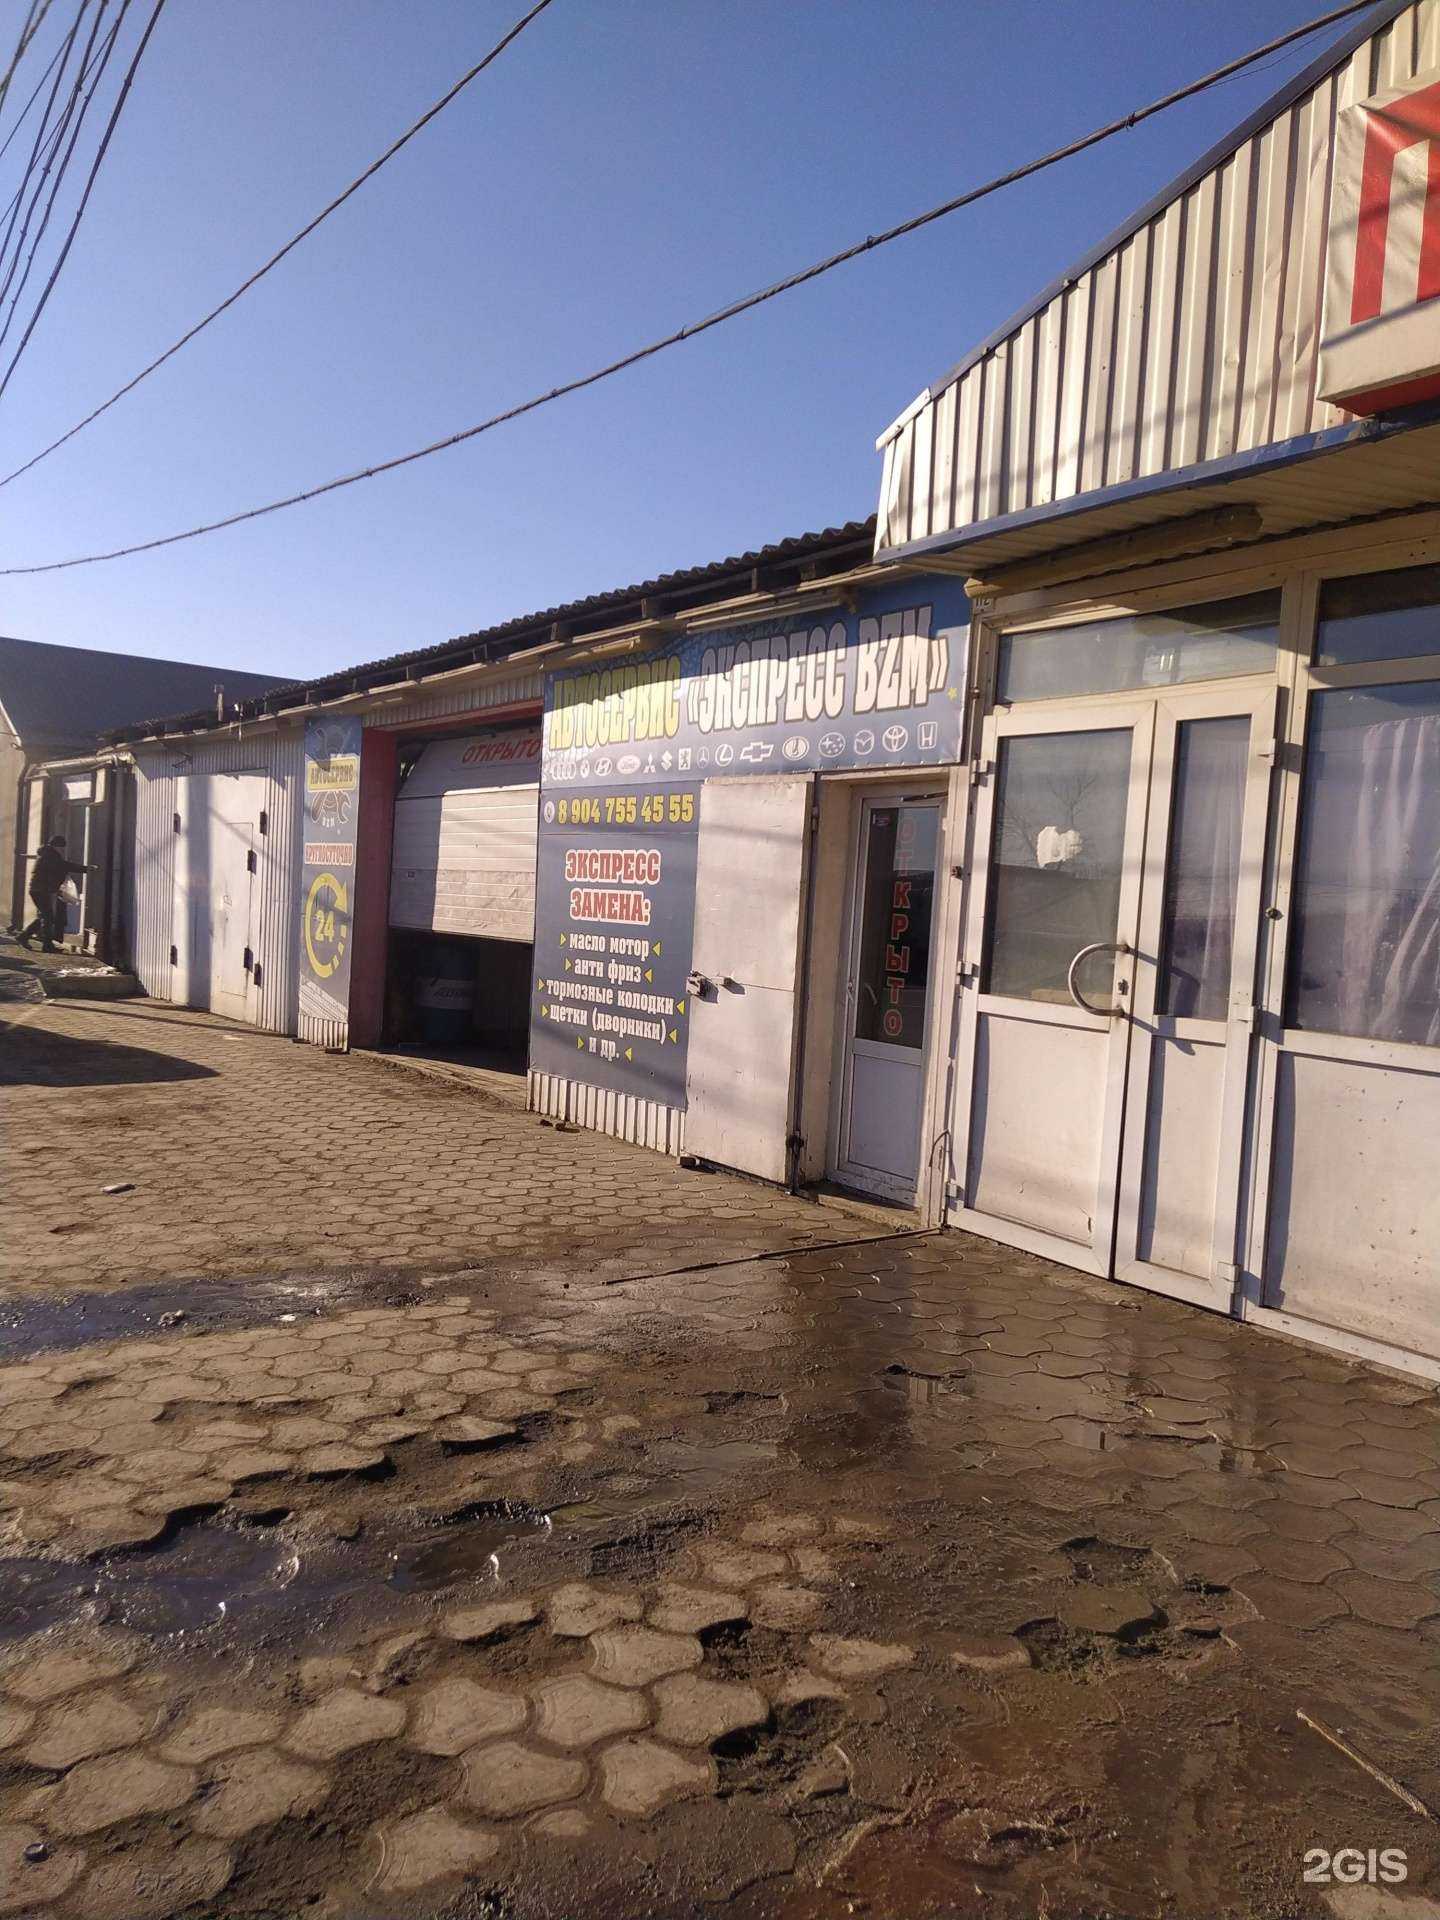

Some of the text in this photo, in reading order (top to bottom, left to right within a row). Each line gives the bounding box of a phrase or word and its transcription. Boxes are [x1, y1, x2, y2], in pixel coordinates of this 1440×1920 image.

[549, 655, 681, 751] АВТОСЕРВИС
[686, 621, 848, 734] «ЭКСПРЕСС
[461, 738, 542, 764] ОТКРЫТО
[557, 794, 694, 824] 8 904 755 45 55
[565, 849, 661, 885] ЭКСПРЕСС
[570, 888, 651, 926] ЗАМЕНА:
[314, 909, 335, 943] 24
[883, 816, 918, 1037] ОТКРЫТО
[569, 933, 649, 962] масло мотор
[574, 958, 642, 985] анти фриз
[546, 979, 674, 1016] тормозные колодки
[550, 1004, 667, 1046] щетки (дворники)
[588, 1036, 620, 1062] и др.
